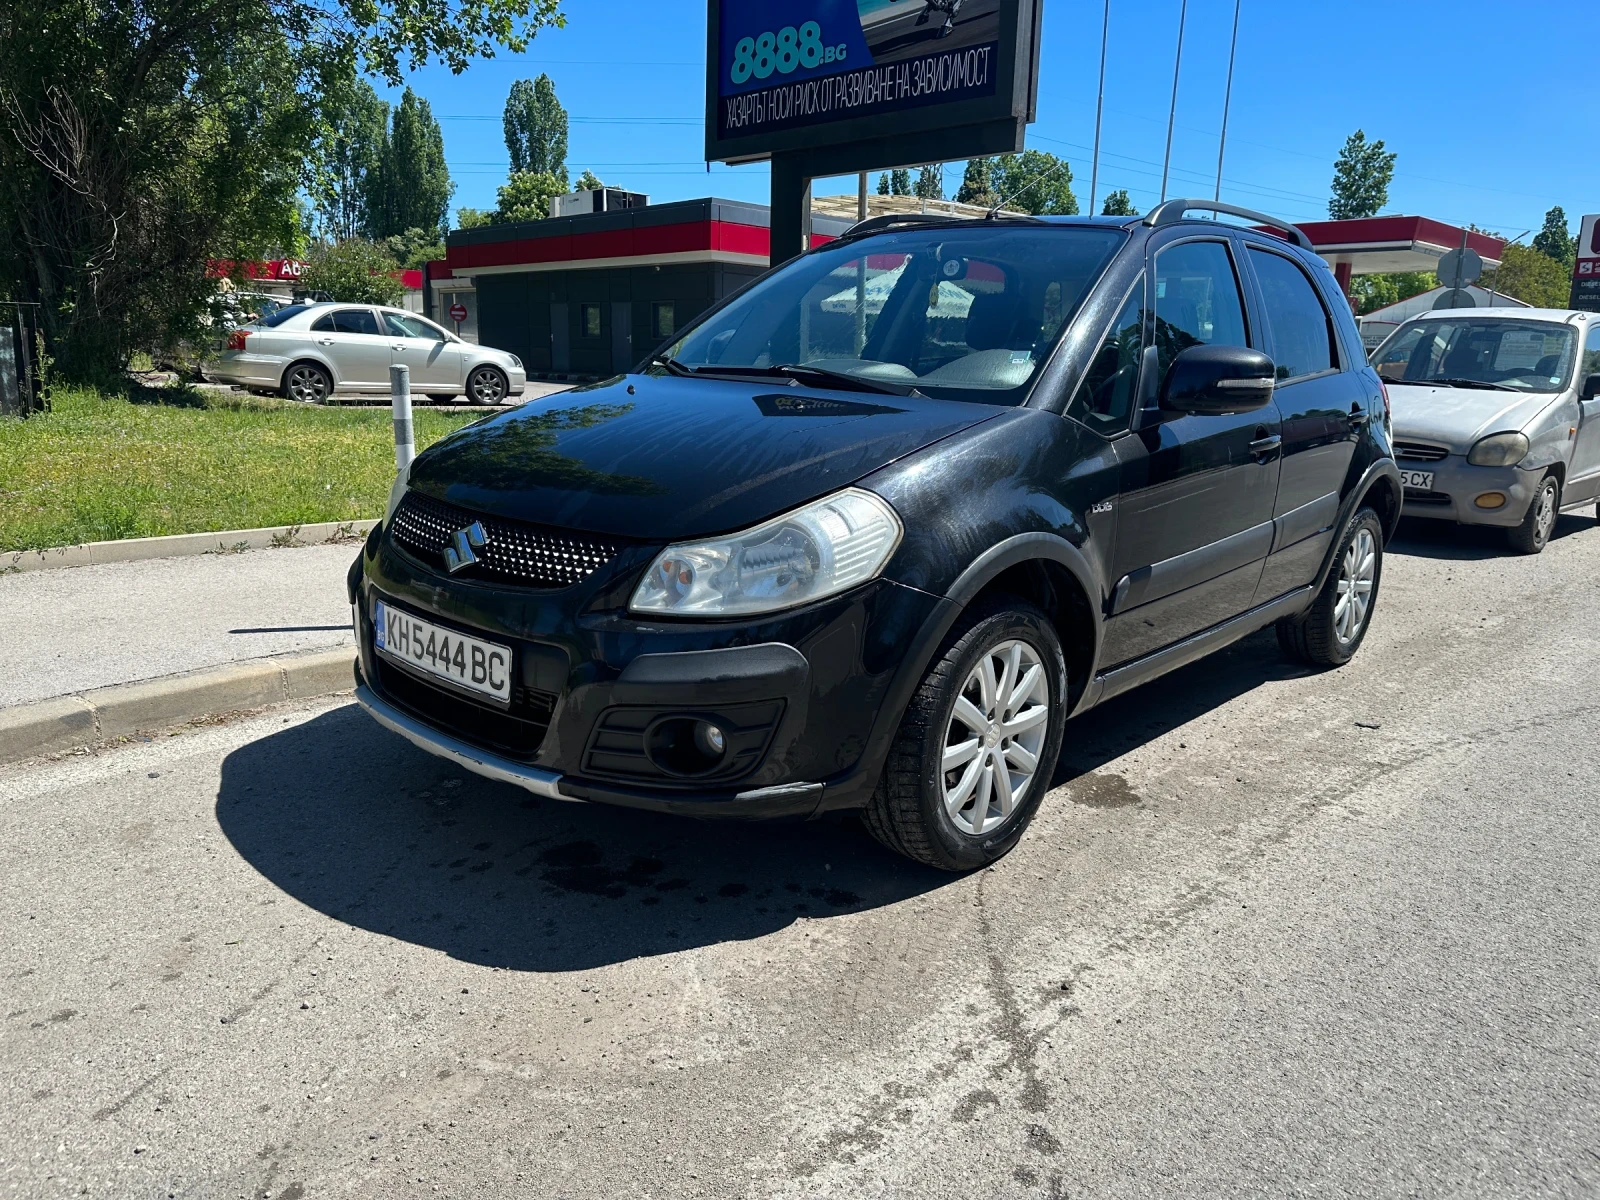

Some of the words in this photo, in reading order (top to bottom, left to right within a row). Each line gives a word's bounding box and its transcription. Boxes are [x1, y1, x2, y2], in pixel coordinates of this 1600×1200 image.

[726, 91, 768, 129] ХАЗАРТЪТ
[769, 86, 793, 121] НОСИ
[795, 81, 820, 116] РИСК
[821, 78, 835, 112] ОТ
[835, 66, 894, 109] РАЗВИВАНЕ
[895, 62, 910, 99] НА
[911, 46, 991, 97] ЗАВИСИМОСТ
[731, 21, 847, 84] 8888.BG
